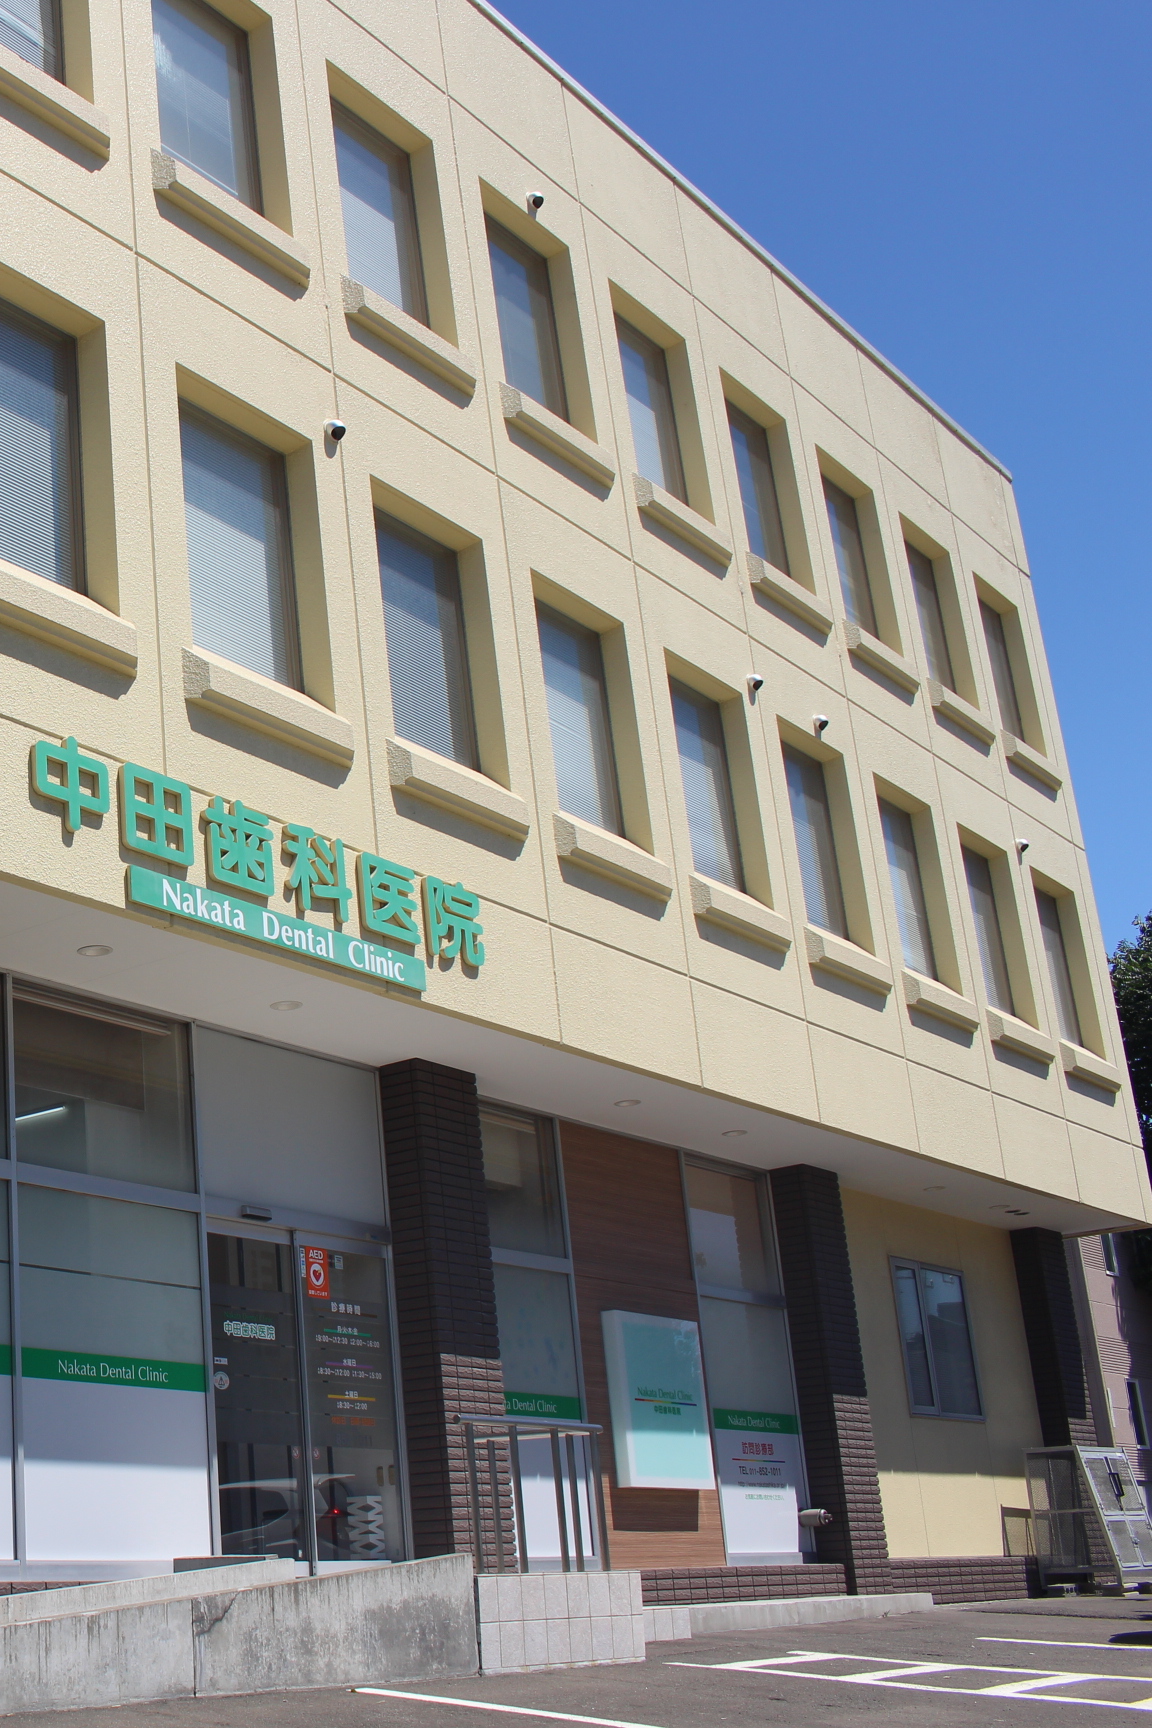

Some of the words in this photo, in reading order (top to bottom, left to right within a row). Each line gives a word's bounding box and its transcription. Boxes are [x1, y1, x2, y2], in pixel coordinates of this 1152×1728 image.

[31, 736, 485, 967] 中田歯科医院
[162, 878, 246, 931] Nakata
[262, 912, 334, 958] Dental
[348, 941, 405, 982] Clinic
[309, 1249, 324, 1260] AED
[223, 1320, 276, 1340] 中田歯科医院
[58, 1359, 97, 1377] Nakata
[100, 1363, 135, 1380] Dental
[138, 1366, 169, 1383] Clinic
[512, 1398, 536, 1411] Dental
[537, 1399, 558, 1413] Clinic
[728, 1415, 747, 1426] Nakata
[747, 1416, 764, 1428] Dental
[765, 1417, 781, 1429] Clinic
[738, 1466, 749, 1475] TEL
